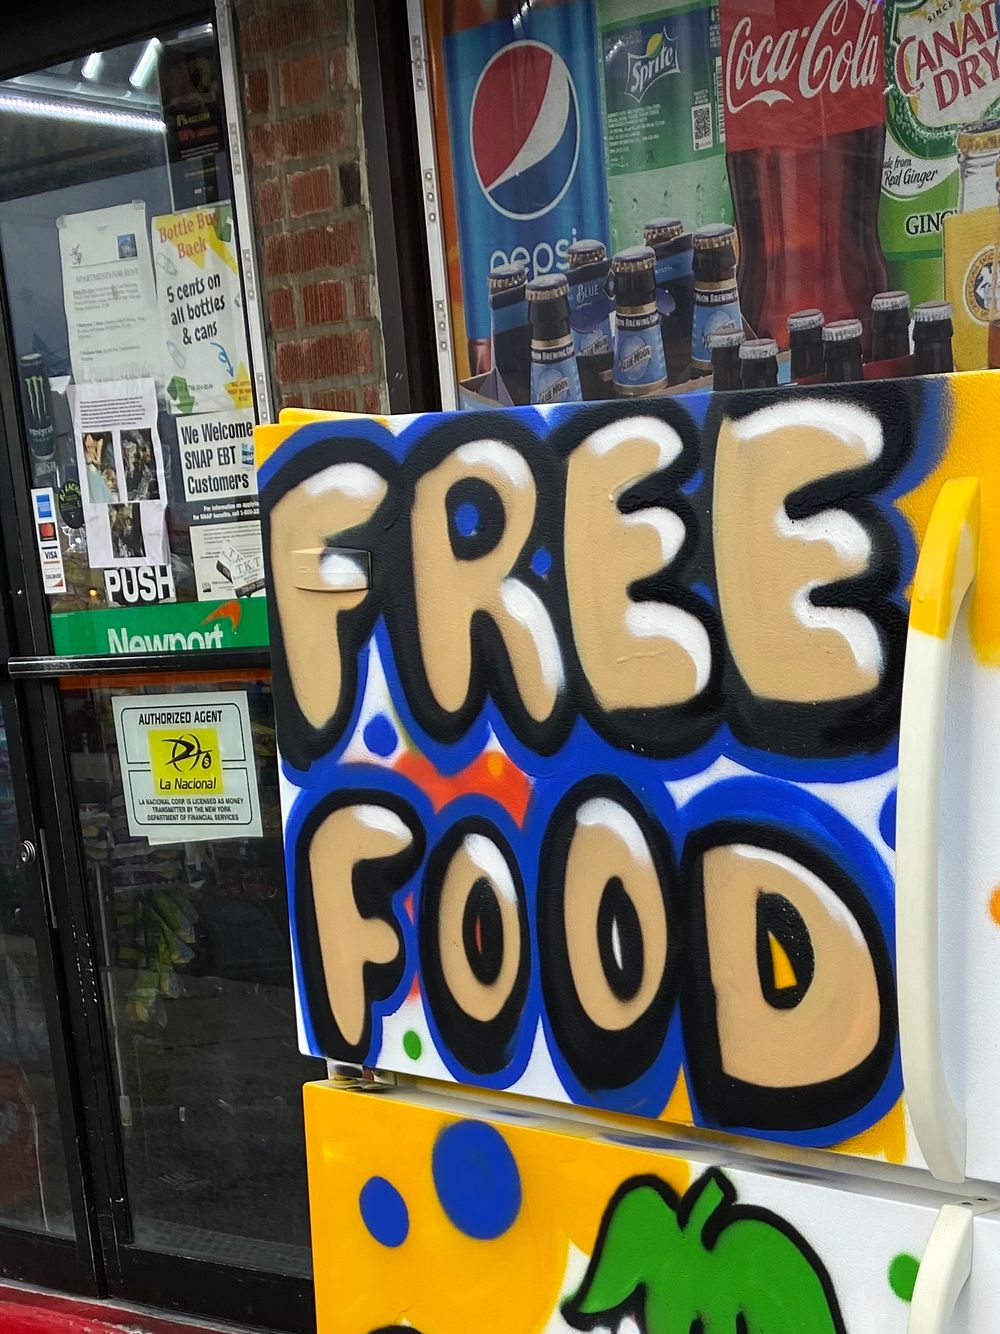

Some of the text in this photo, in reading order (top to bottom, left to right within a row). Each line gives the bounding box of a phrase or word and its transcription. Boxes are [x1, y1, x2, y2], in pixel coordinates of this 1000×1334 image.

[631, 44, 674, 93] Sprite
[726, 0, 879, 113] Coca-Cola
[933, 40, 1000, 111] DRY
[894, 155, 912, 170] from
[884, 168, 938, 188] Real Ginger
[159, 217, 195, 243] Bottle
[177, 238, 208, 259] Back
[167, 273, 221, 303] 5 cents on
[170, 295, 226, 325] all bottles
[182, 321, 218, 345] & cans
[181, 421, 253, 445] We Welcome
[184, 445, 236, 470] SNAP EBT
[187, 473, 249, 495] Customers
[44, 550, 58, 560] VISA
[104, 564, 174, 603] PUSH
[262, 392, 900, 755] FREE
[107, 623, 224, 654] Newport
[138, 710, 223, 726] AUTHORIZED AGENT
[159, 777, 217, 790] La Nacional
[298, 785, 892, 1115] FOOD
